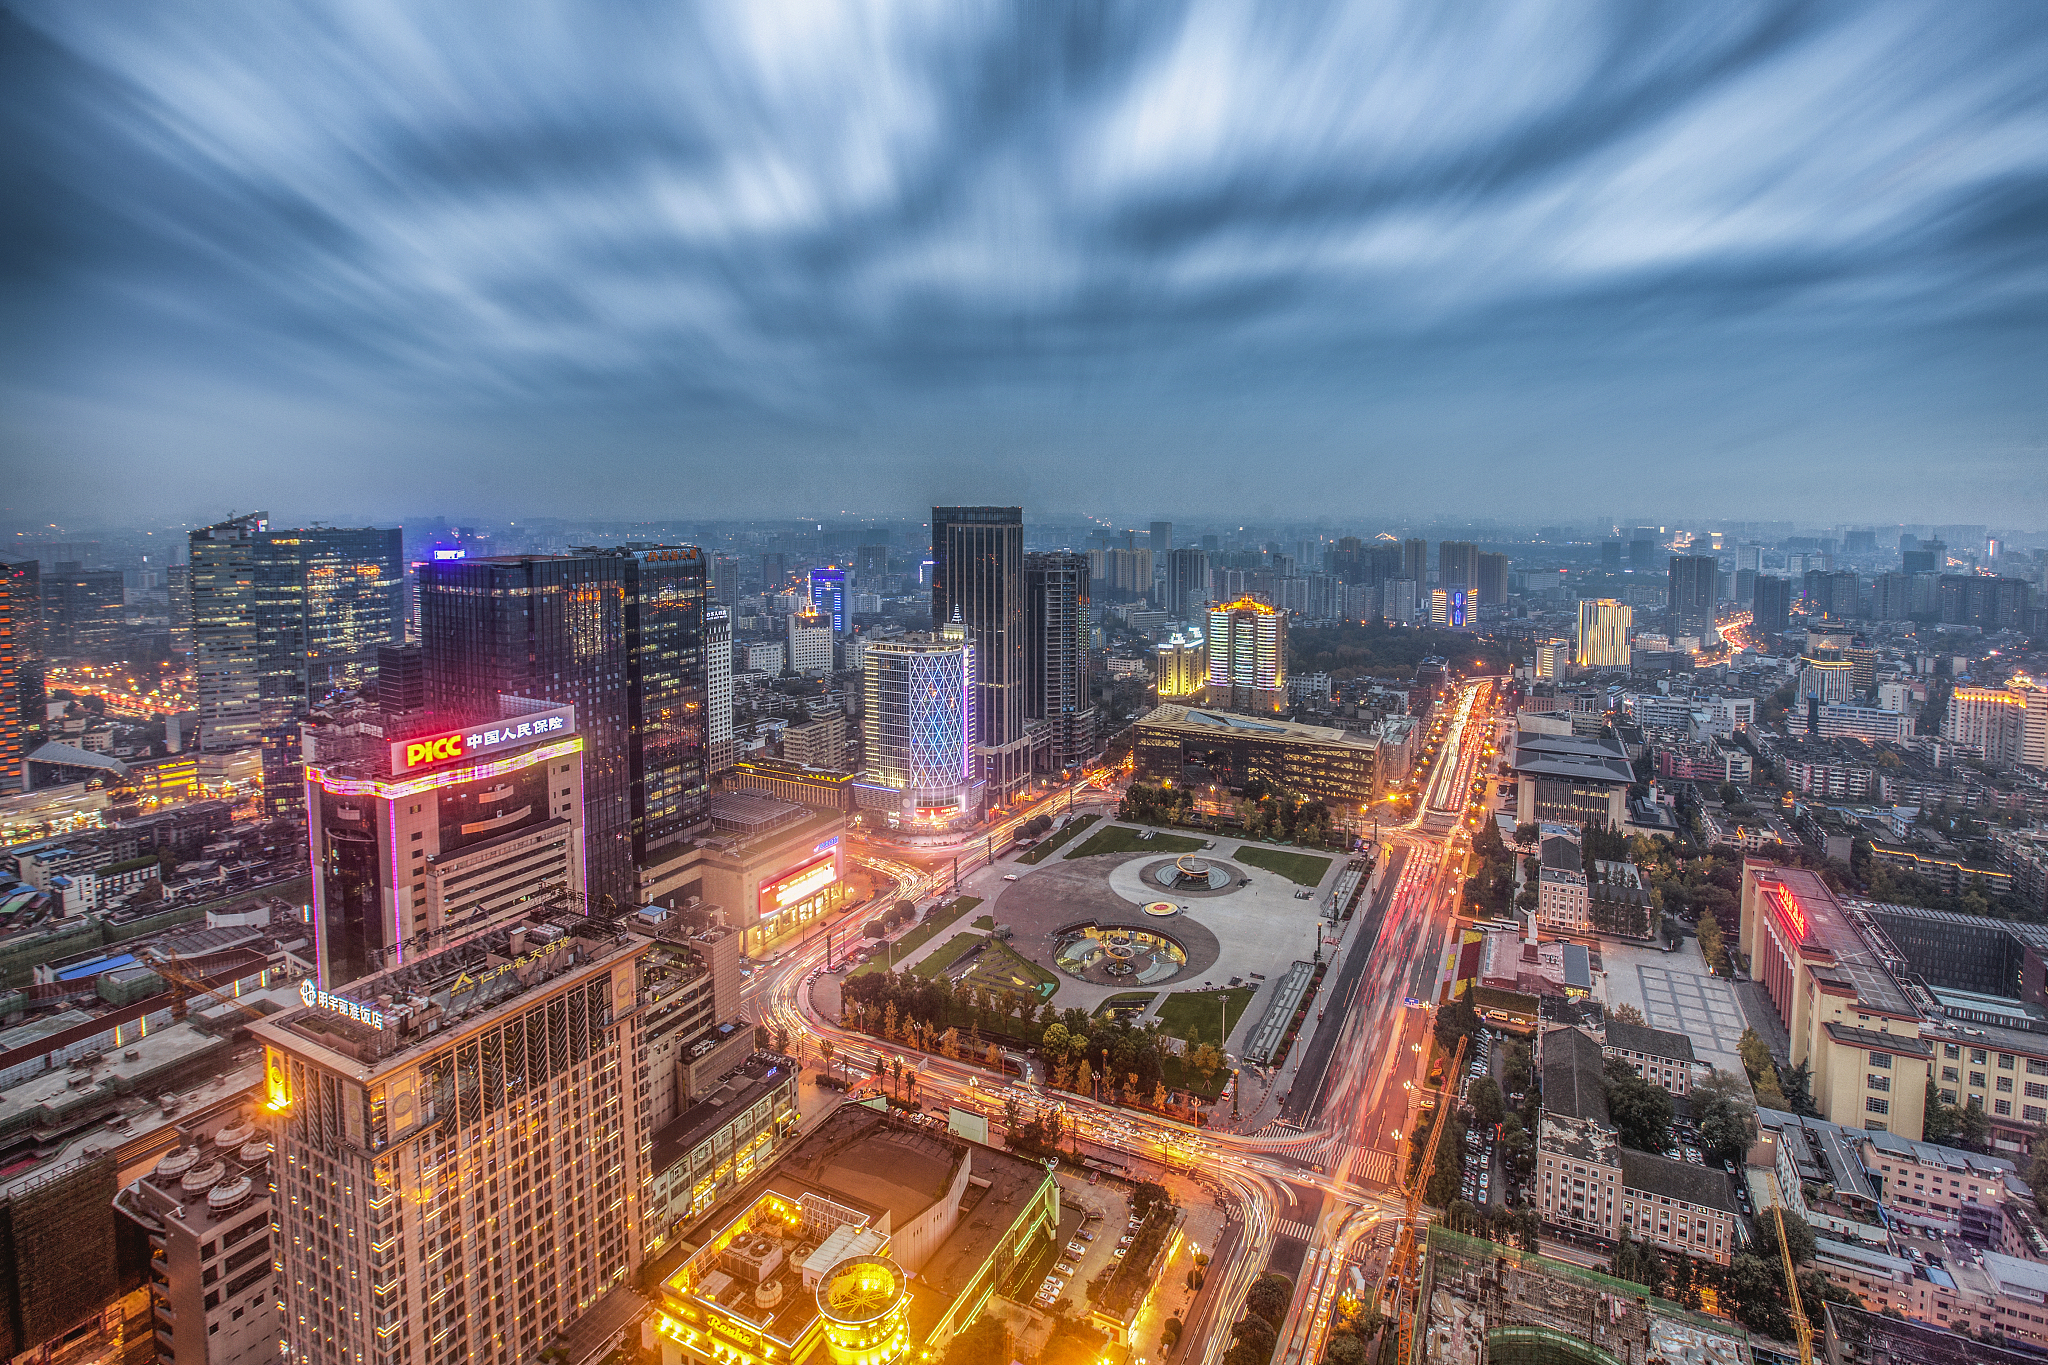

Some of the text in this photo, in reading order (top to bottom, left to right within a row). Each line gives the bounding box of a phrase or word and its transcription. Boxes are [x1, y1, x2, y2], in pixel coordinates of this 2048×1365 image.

[466, 716, 563, 749] 中国人民保险
[407, 734, 462, 767] PICC
[478, 935, 571, 984] 仁和春天百货
[317, 990, 383, 1031] 明宇丽雅饭店
[707, 1314, 752, 1345] Renhe
